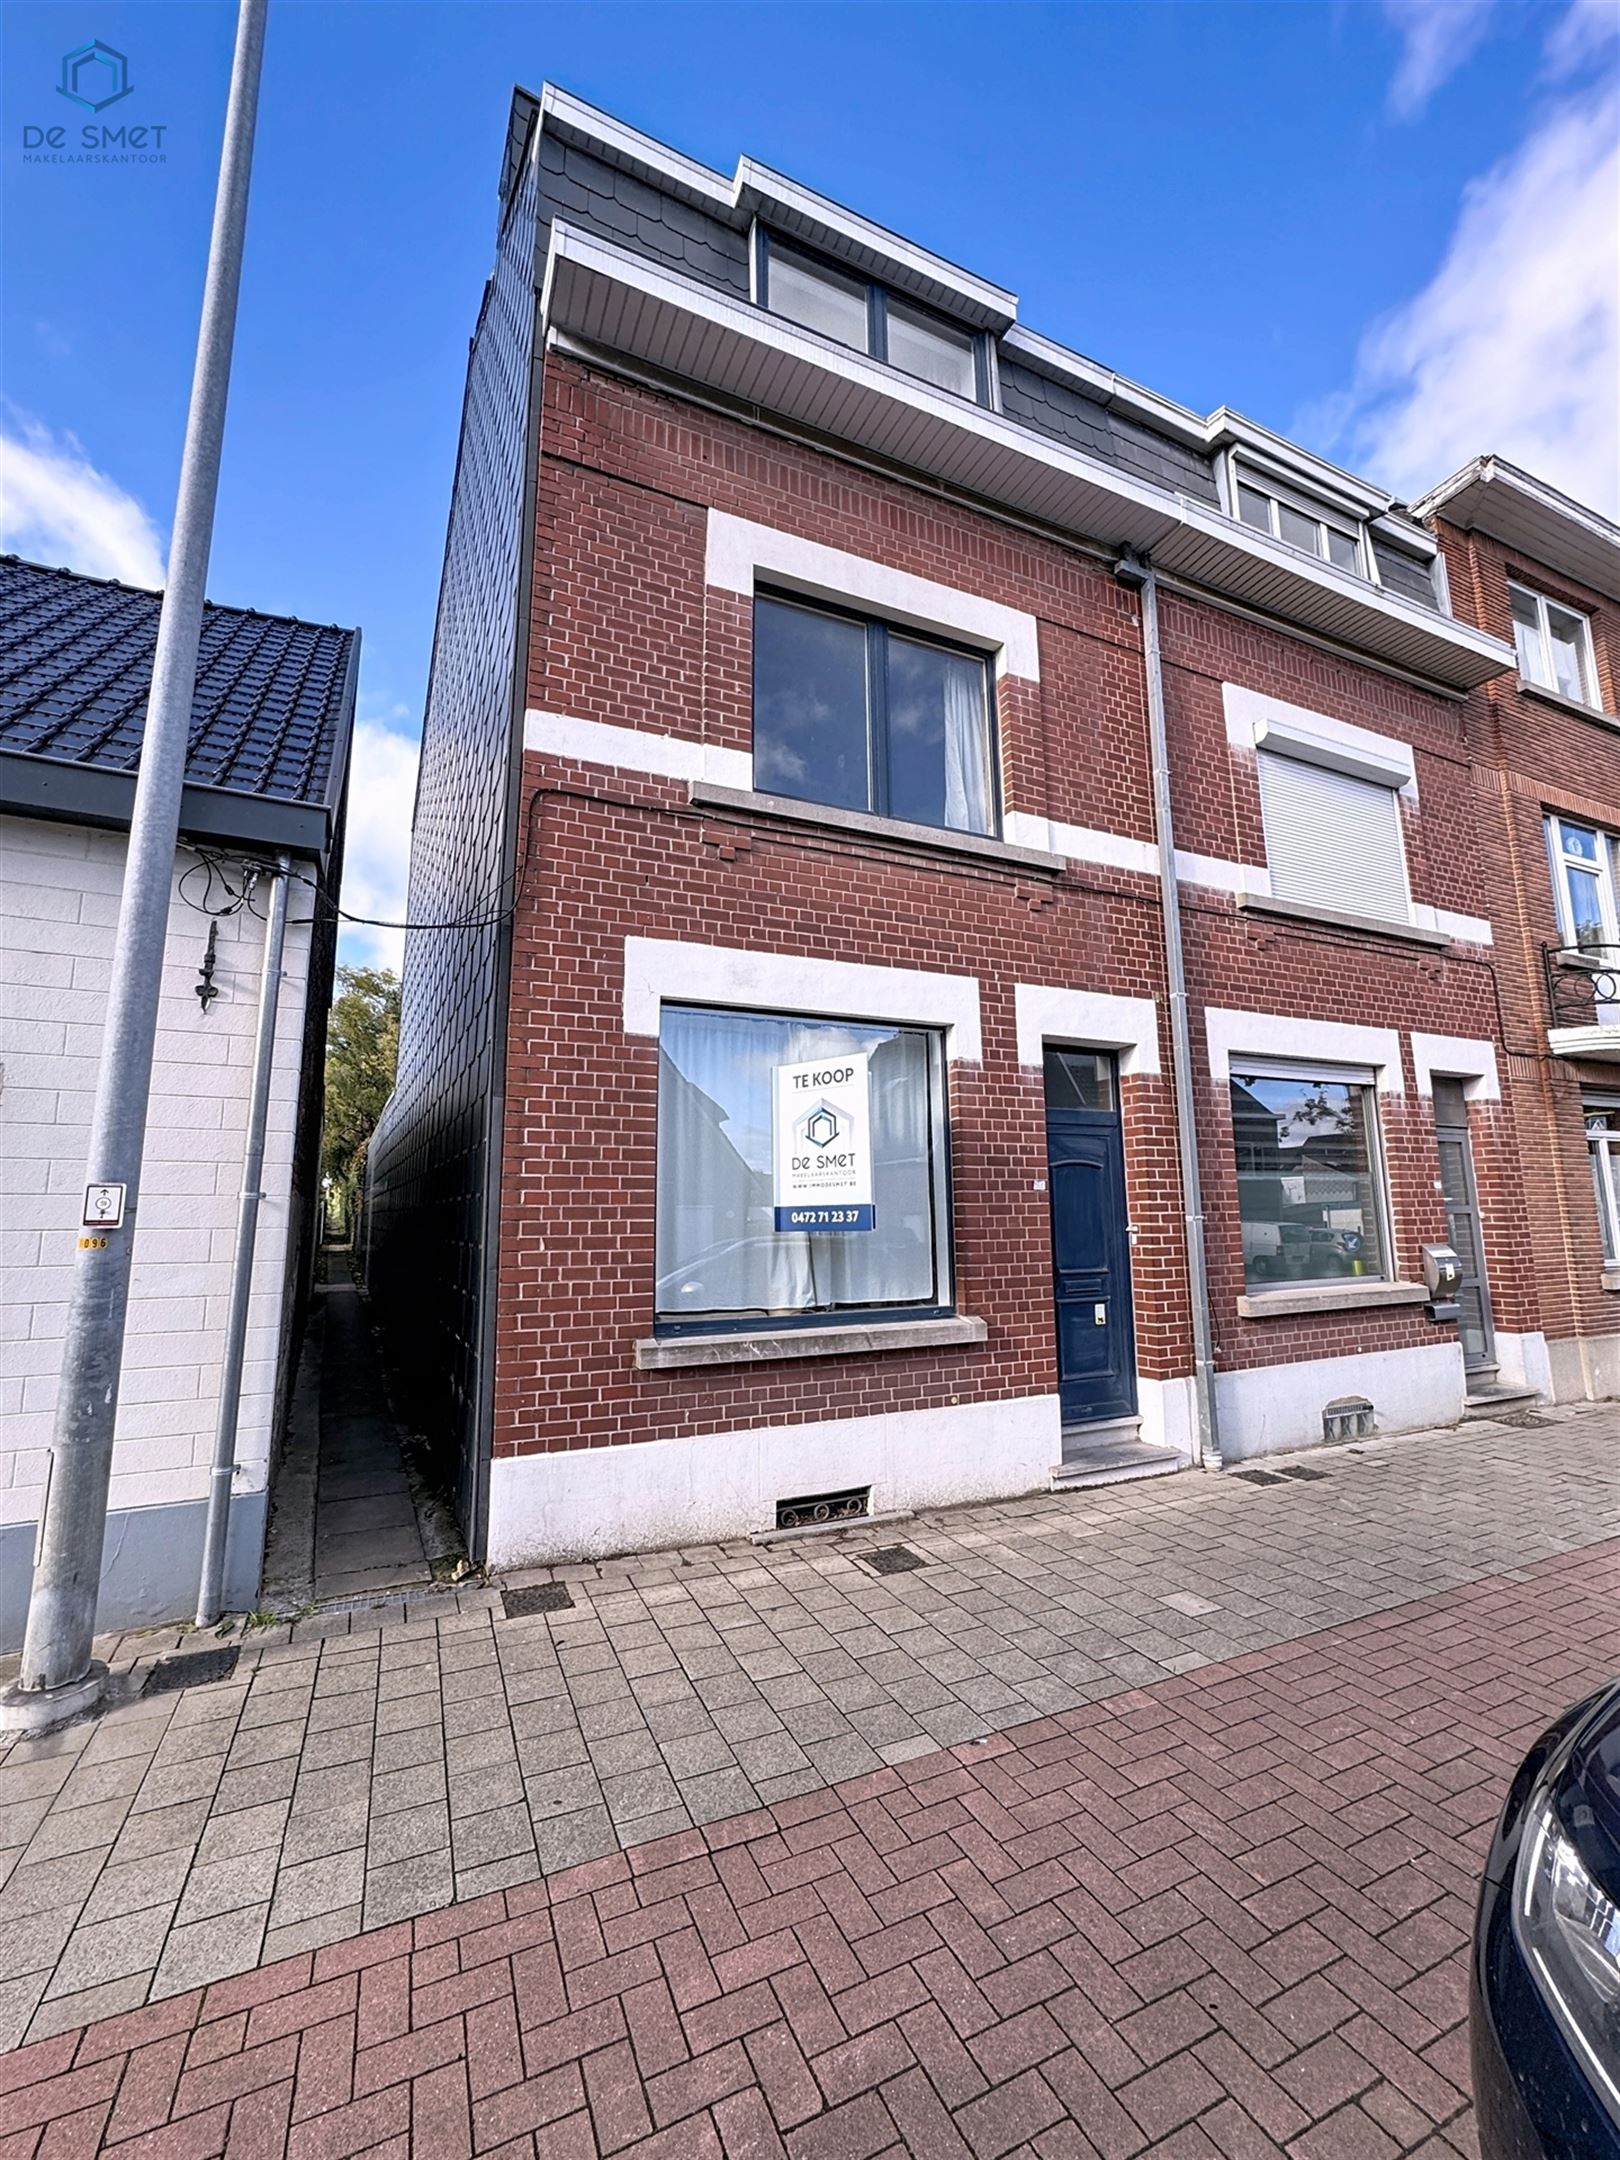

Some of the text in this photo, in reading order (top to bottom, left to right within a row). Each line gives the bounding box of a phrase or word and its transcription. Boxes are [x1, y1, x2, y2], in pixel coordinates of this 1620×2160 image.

[792, 1067, 854, 1089] TE KOOP
[791, 1210, 859, 1223] 0472 71 23 37
